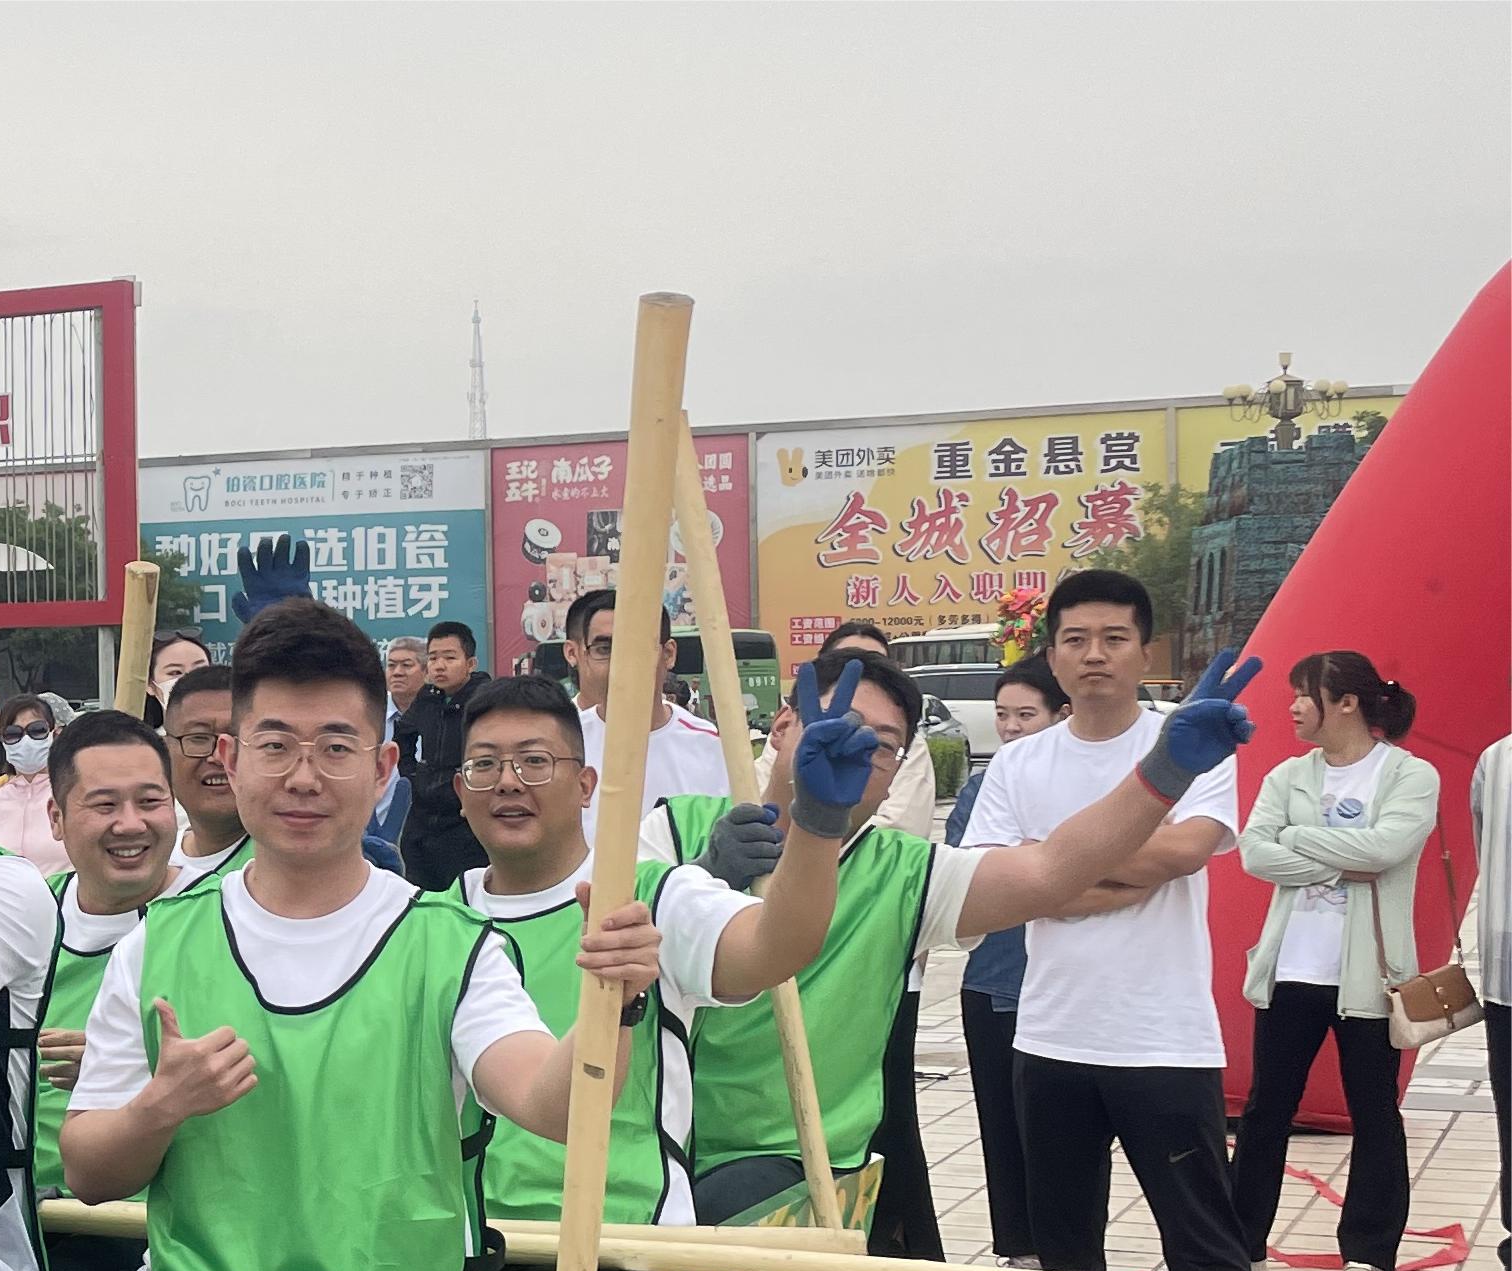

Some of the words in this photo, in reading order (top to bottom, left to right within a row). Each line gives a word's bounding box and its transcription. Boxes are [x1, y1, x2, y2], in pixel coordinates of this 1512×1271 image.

[814, 446, 896, 469] 美团外卖
[934, 431, 1141, 481] 重金悬赏
[226, 472, 327, 493] 伯瓷口腔医院
[551, 455, 613, 484] 南瓜子
[250, 497, 277, 506] TEETH
[281, 495, 326, 505] HOSPITAL
[815, 480, 1145, 567] 全城招募
